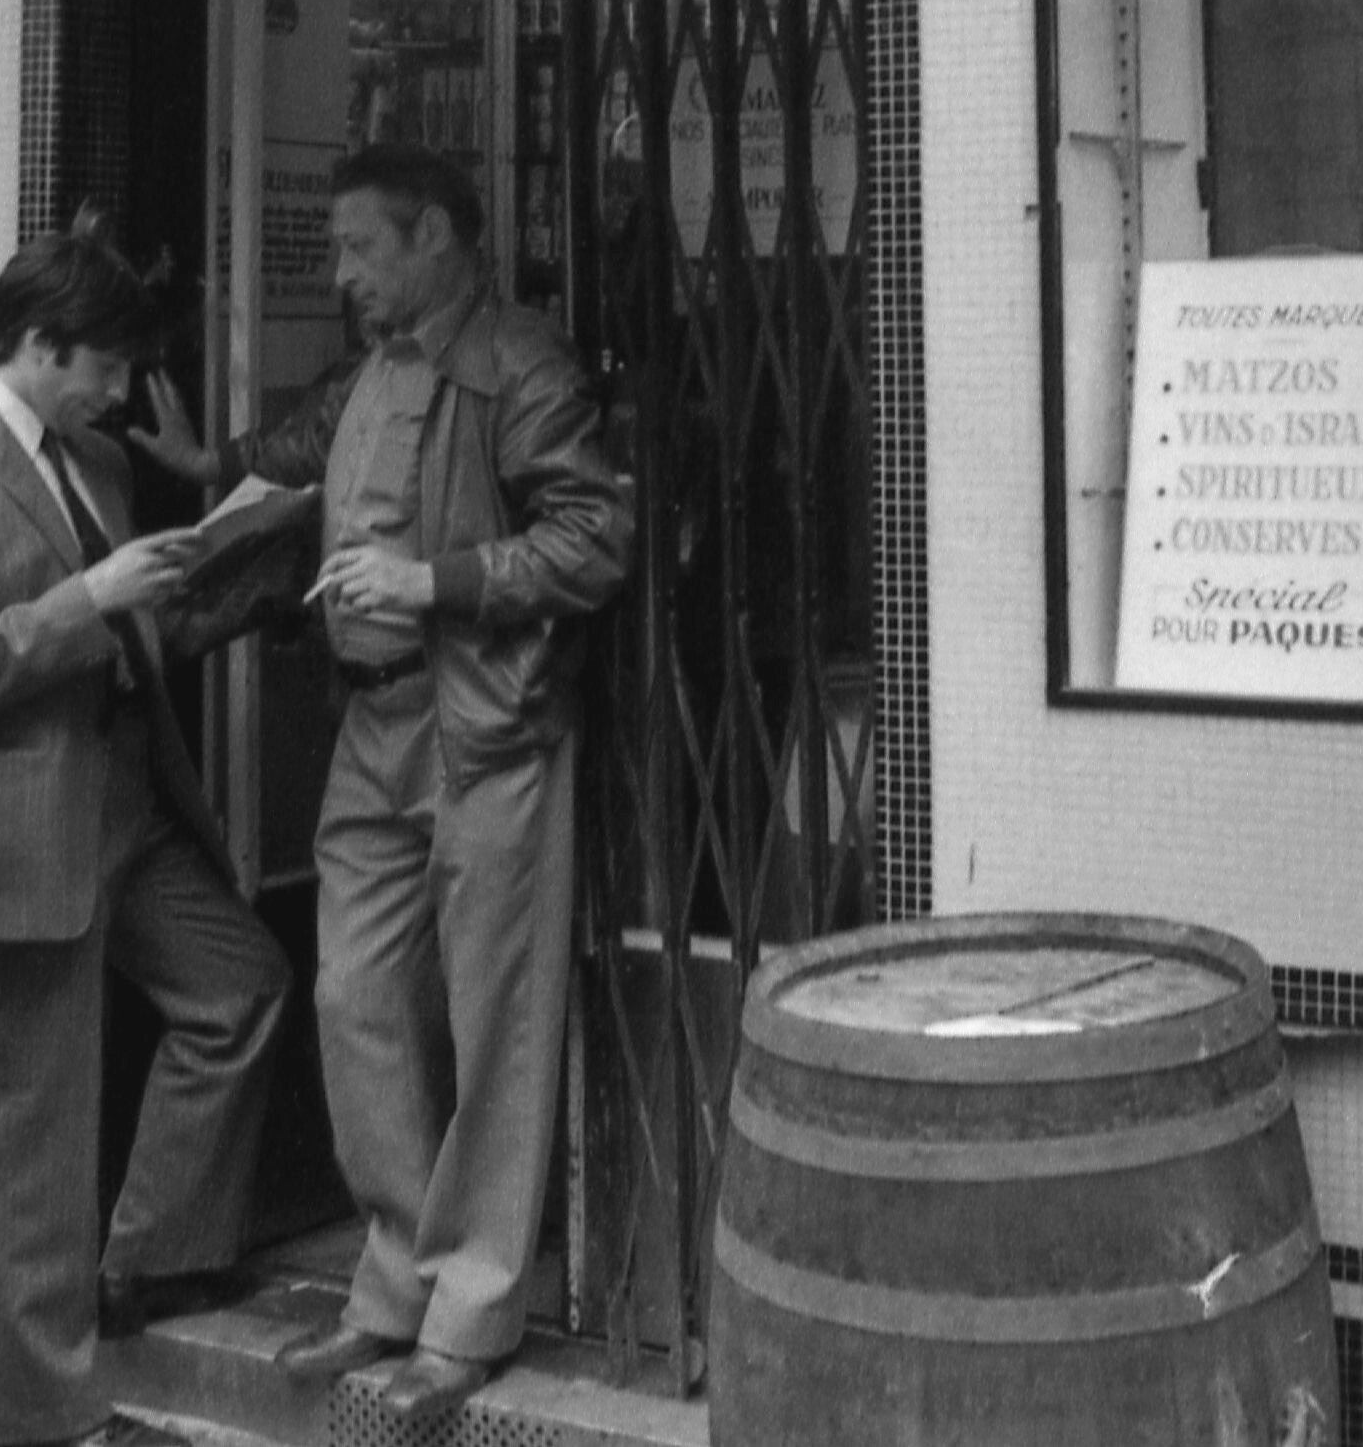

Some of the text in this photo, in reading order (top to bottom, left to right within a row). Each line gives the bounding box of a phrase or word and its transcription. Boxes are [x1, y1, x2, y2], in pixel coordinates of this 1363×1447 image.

[1177, 304, 1262, 329] TOUTES
[1183, 358, 1339, 395] MATZOS
[1178, 411, 1256, 447] VINS
[1171, 516, 1362, 555] CONSERVES
[1151, 615, 1219, 645] POUR
